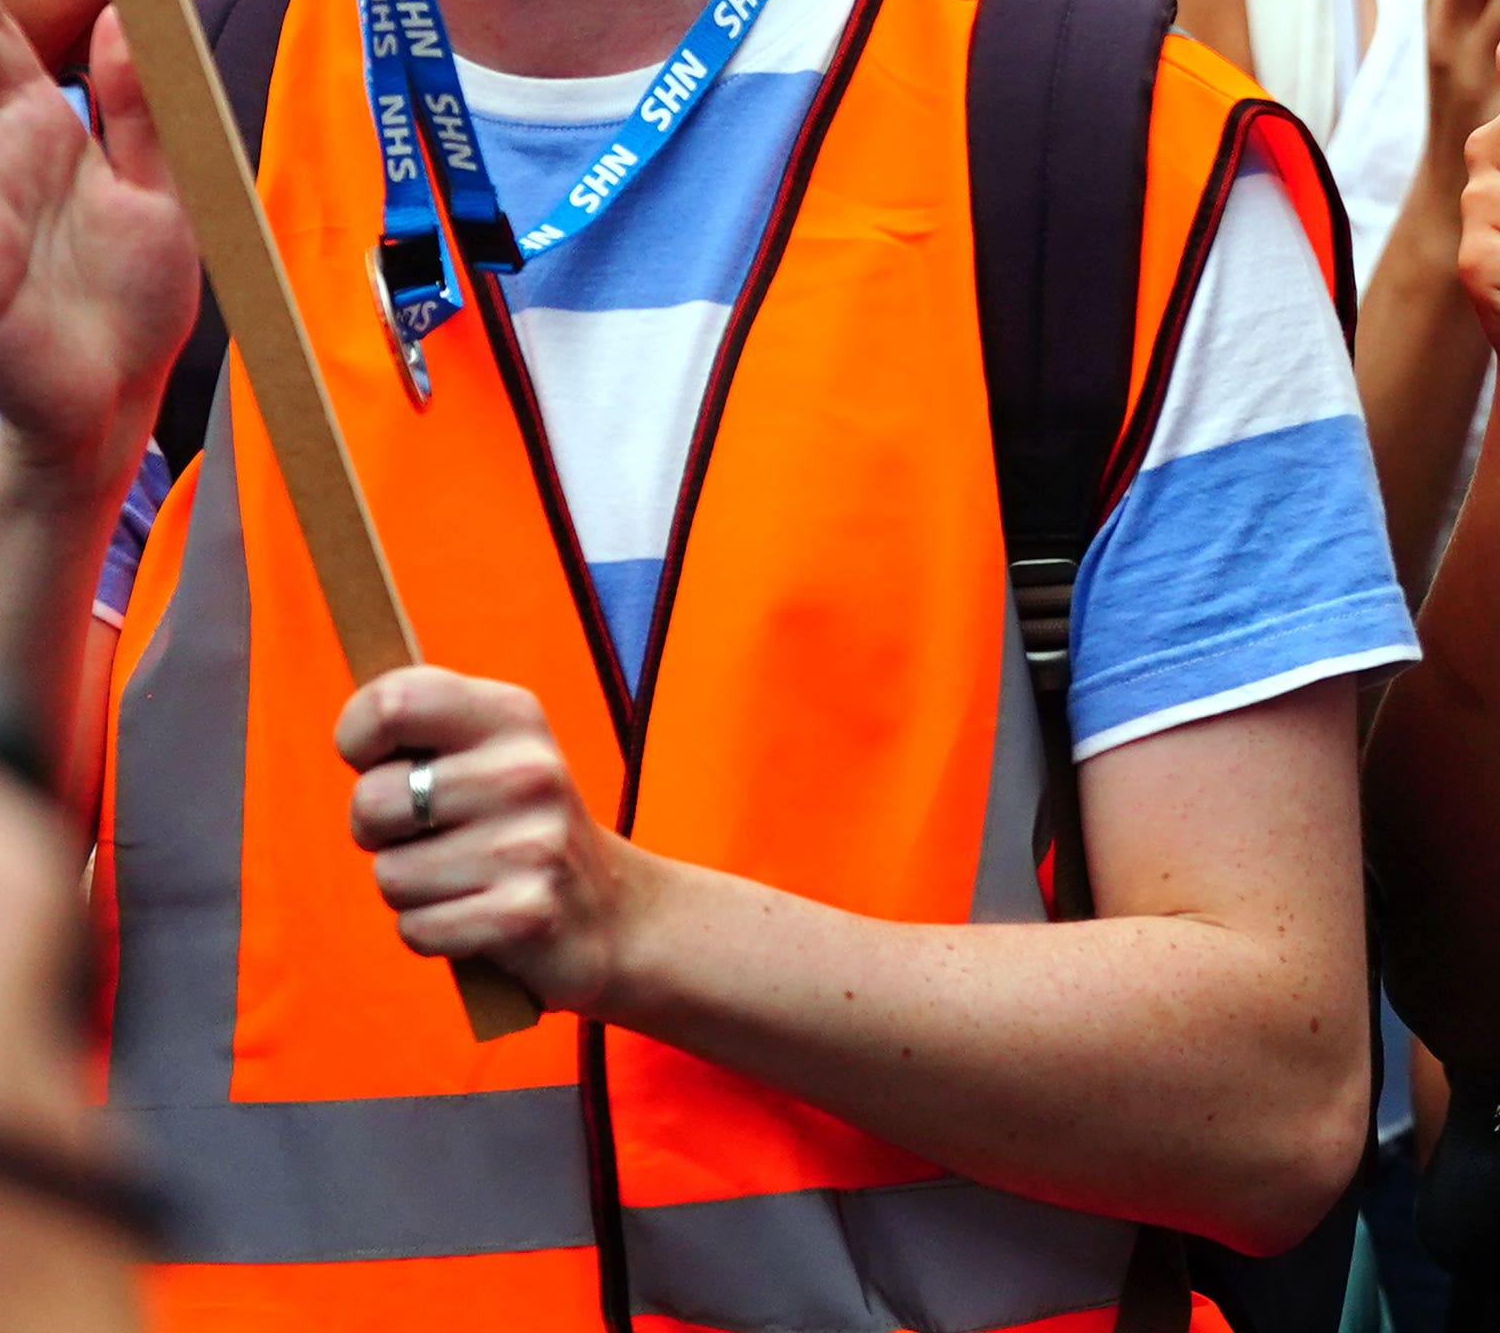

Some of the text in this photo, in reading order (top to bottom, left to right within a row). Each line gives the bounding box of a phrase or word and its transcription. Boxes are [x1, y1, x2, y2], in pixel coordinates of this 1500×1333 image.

[640, 48, 709, 133] NHS
[379, 94, 417, 183] NHS
[425, 93, 476, 172] NHS
[570, 143, 638, 215] NHS
